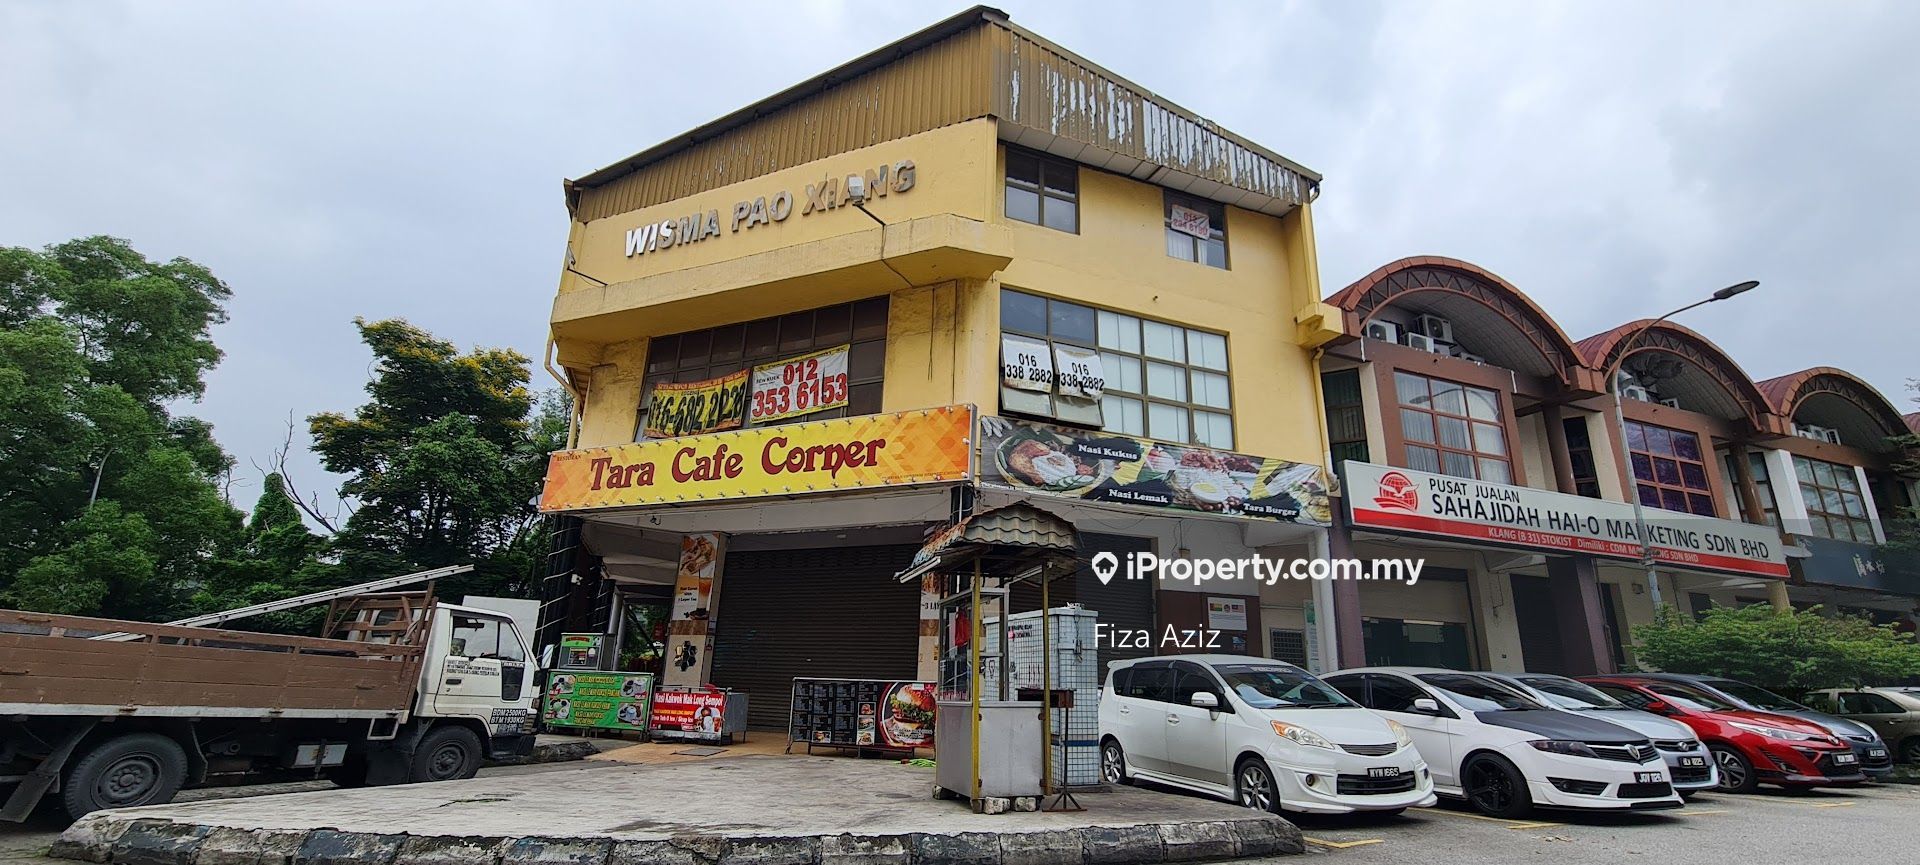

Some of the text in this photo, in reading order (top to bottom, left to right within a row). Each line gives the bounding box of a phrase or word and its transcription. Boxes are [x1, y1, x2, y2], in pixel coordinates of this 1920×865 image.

[625, 209, 720, 258] WISMA
[731, 190, 794, 232] PAO
[1018, 353, 1037, 367] 016
[1071, 362, 1089, 376] 016
[783, 358, 818, 386] 012
[1006, 364, 1052, 384] 338 2882
[1060, 373, 1105, 391] 338 2882
[752, 386, 790, 417] 353
[796, 372, 847, 410] 6153
[590, 436, 886, 491] Tara Cafe Corner
[1078, 444, 1138, 460] Nasi Kukus
[1108, 488, 1168, 503] Nasi Lemak
[1429, 478, 1520, 504] PUSAT JUALAN
[1243, 502, 1297, 516] Tara Burger
[1432, 493, 1541, 528] SAHAJIDAH
[1547, 509, 1600, 536] HAI-O
[1704, 533, 1737, 554] SDN
[1739, 538, 1769, 559] BHD
[1488, 527, 1516, 541] KLANG
[1541, 534, 1572, 547] STOKIST
[1610, 543, 1627, 554] CDM
